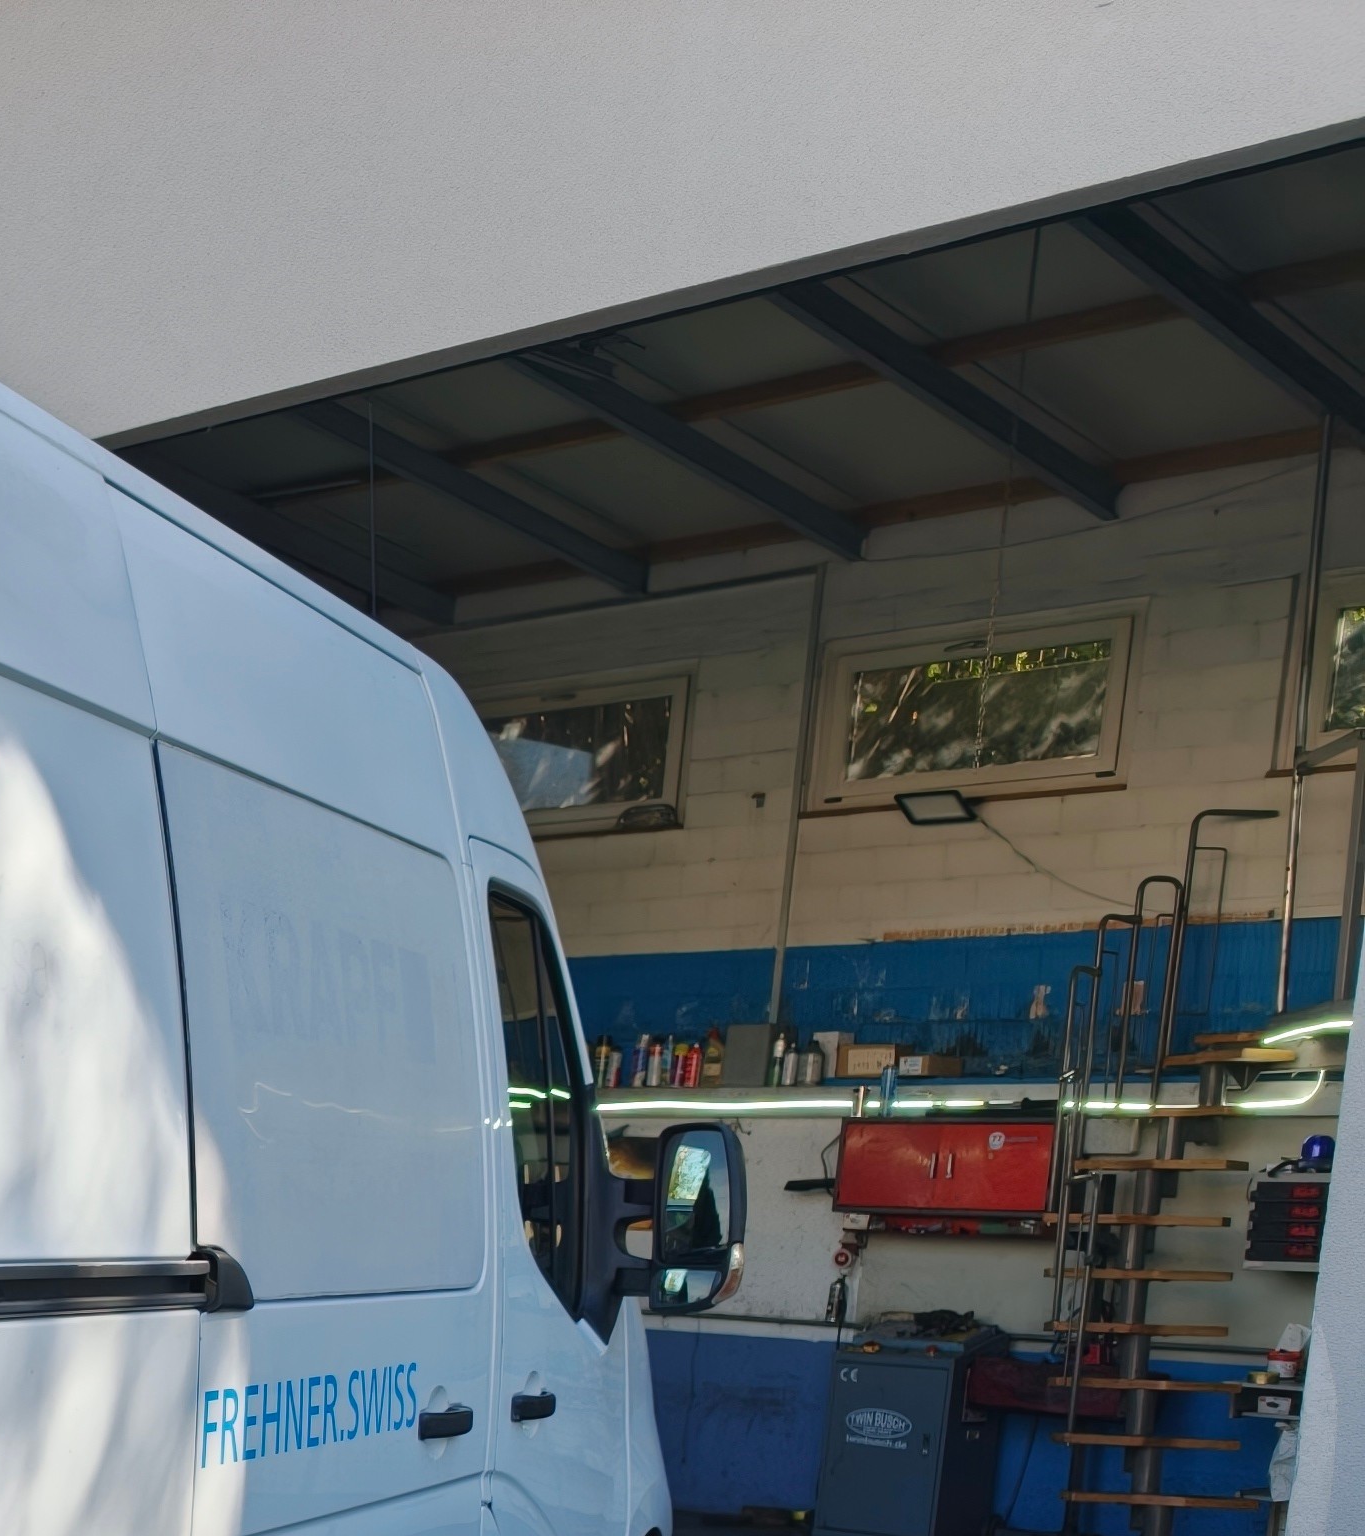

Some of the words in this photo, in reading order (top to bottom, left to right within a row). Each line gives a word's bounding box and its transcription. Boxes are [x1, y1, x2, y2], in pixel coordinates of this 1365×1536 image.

[201, 1362, 417, 1469] FREHNER.SWISS
[851, 1411, 874, 1428] TWIN
[875, 1411, 907, 1432] BUSCH
